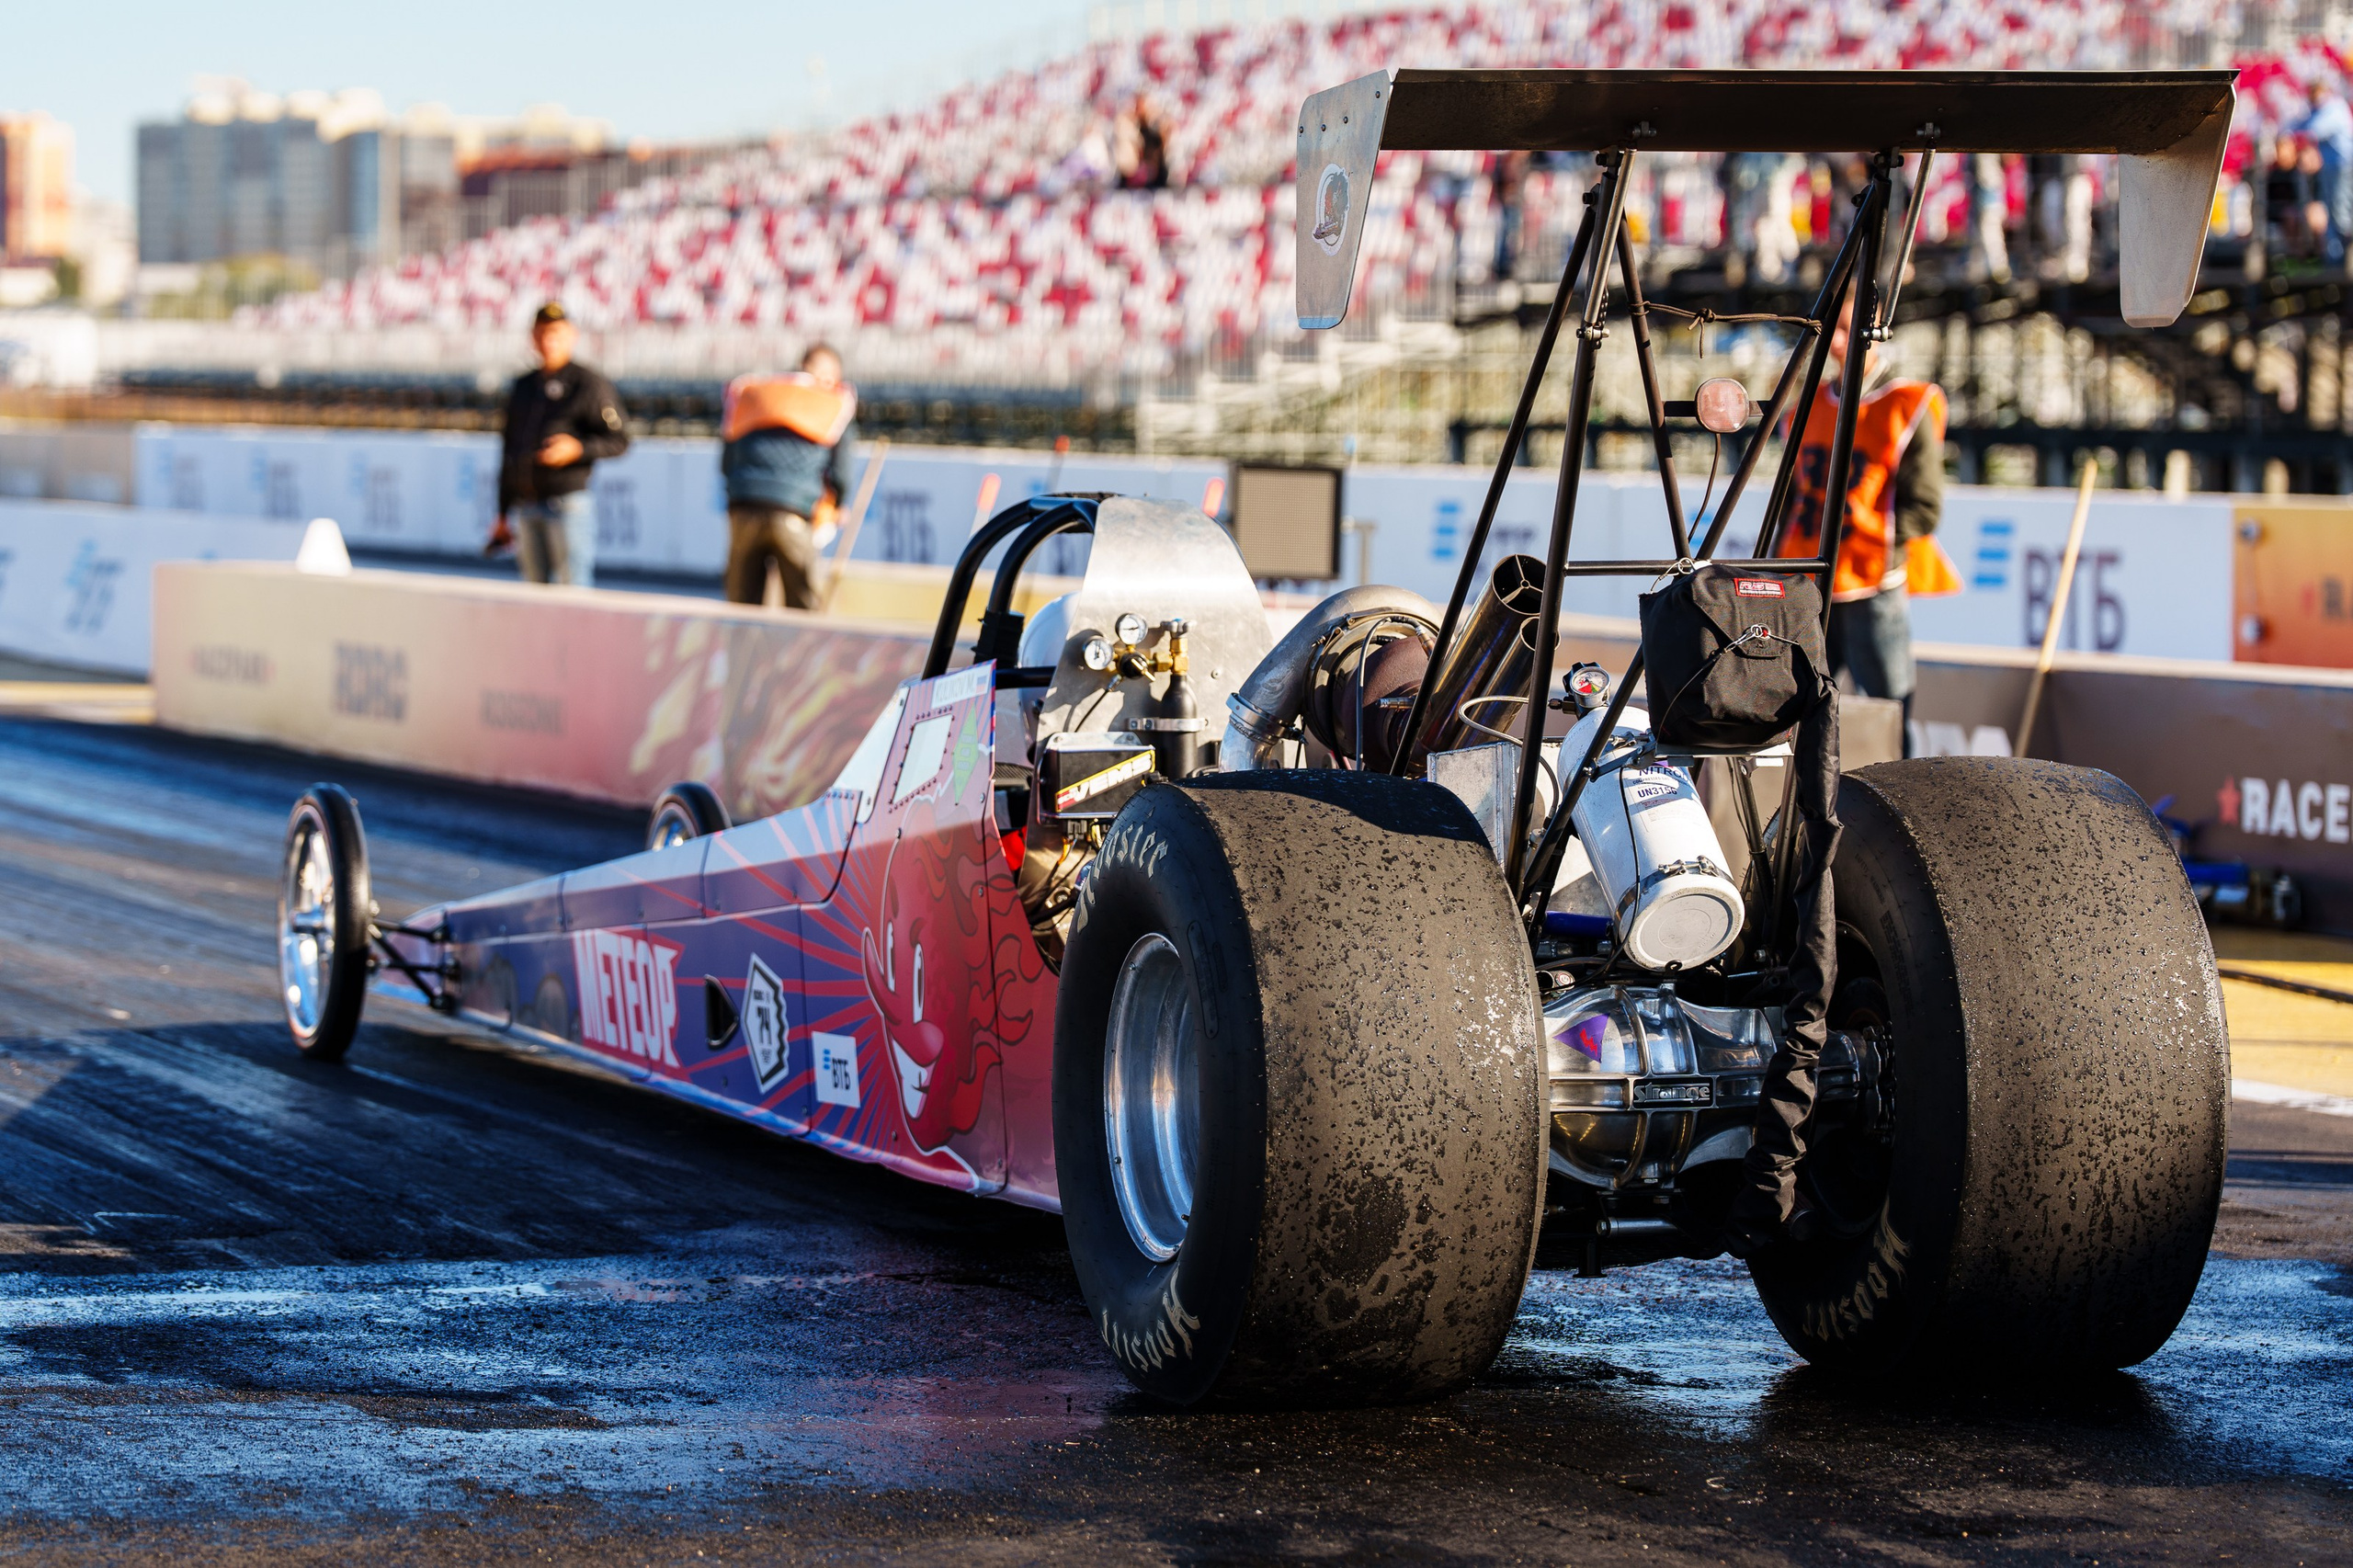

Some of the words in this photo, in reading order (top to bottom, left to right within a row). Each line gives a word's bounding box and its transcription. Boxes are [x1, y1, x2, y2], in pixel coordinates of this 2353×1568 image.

[2024, 549, 2128, 652] ВТБ
[1069, 754, 1152, 802] VEMS
[2240, 777, 2353, 845] RACE
[831, 1057, 851, 1091] ВТБ
[1633, 1082, 1711, 1104] Strange
